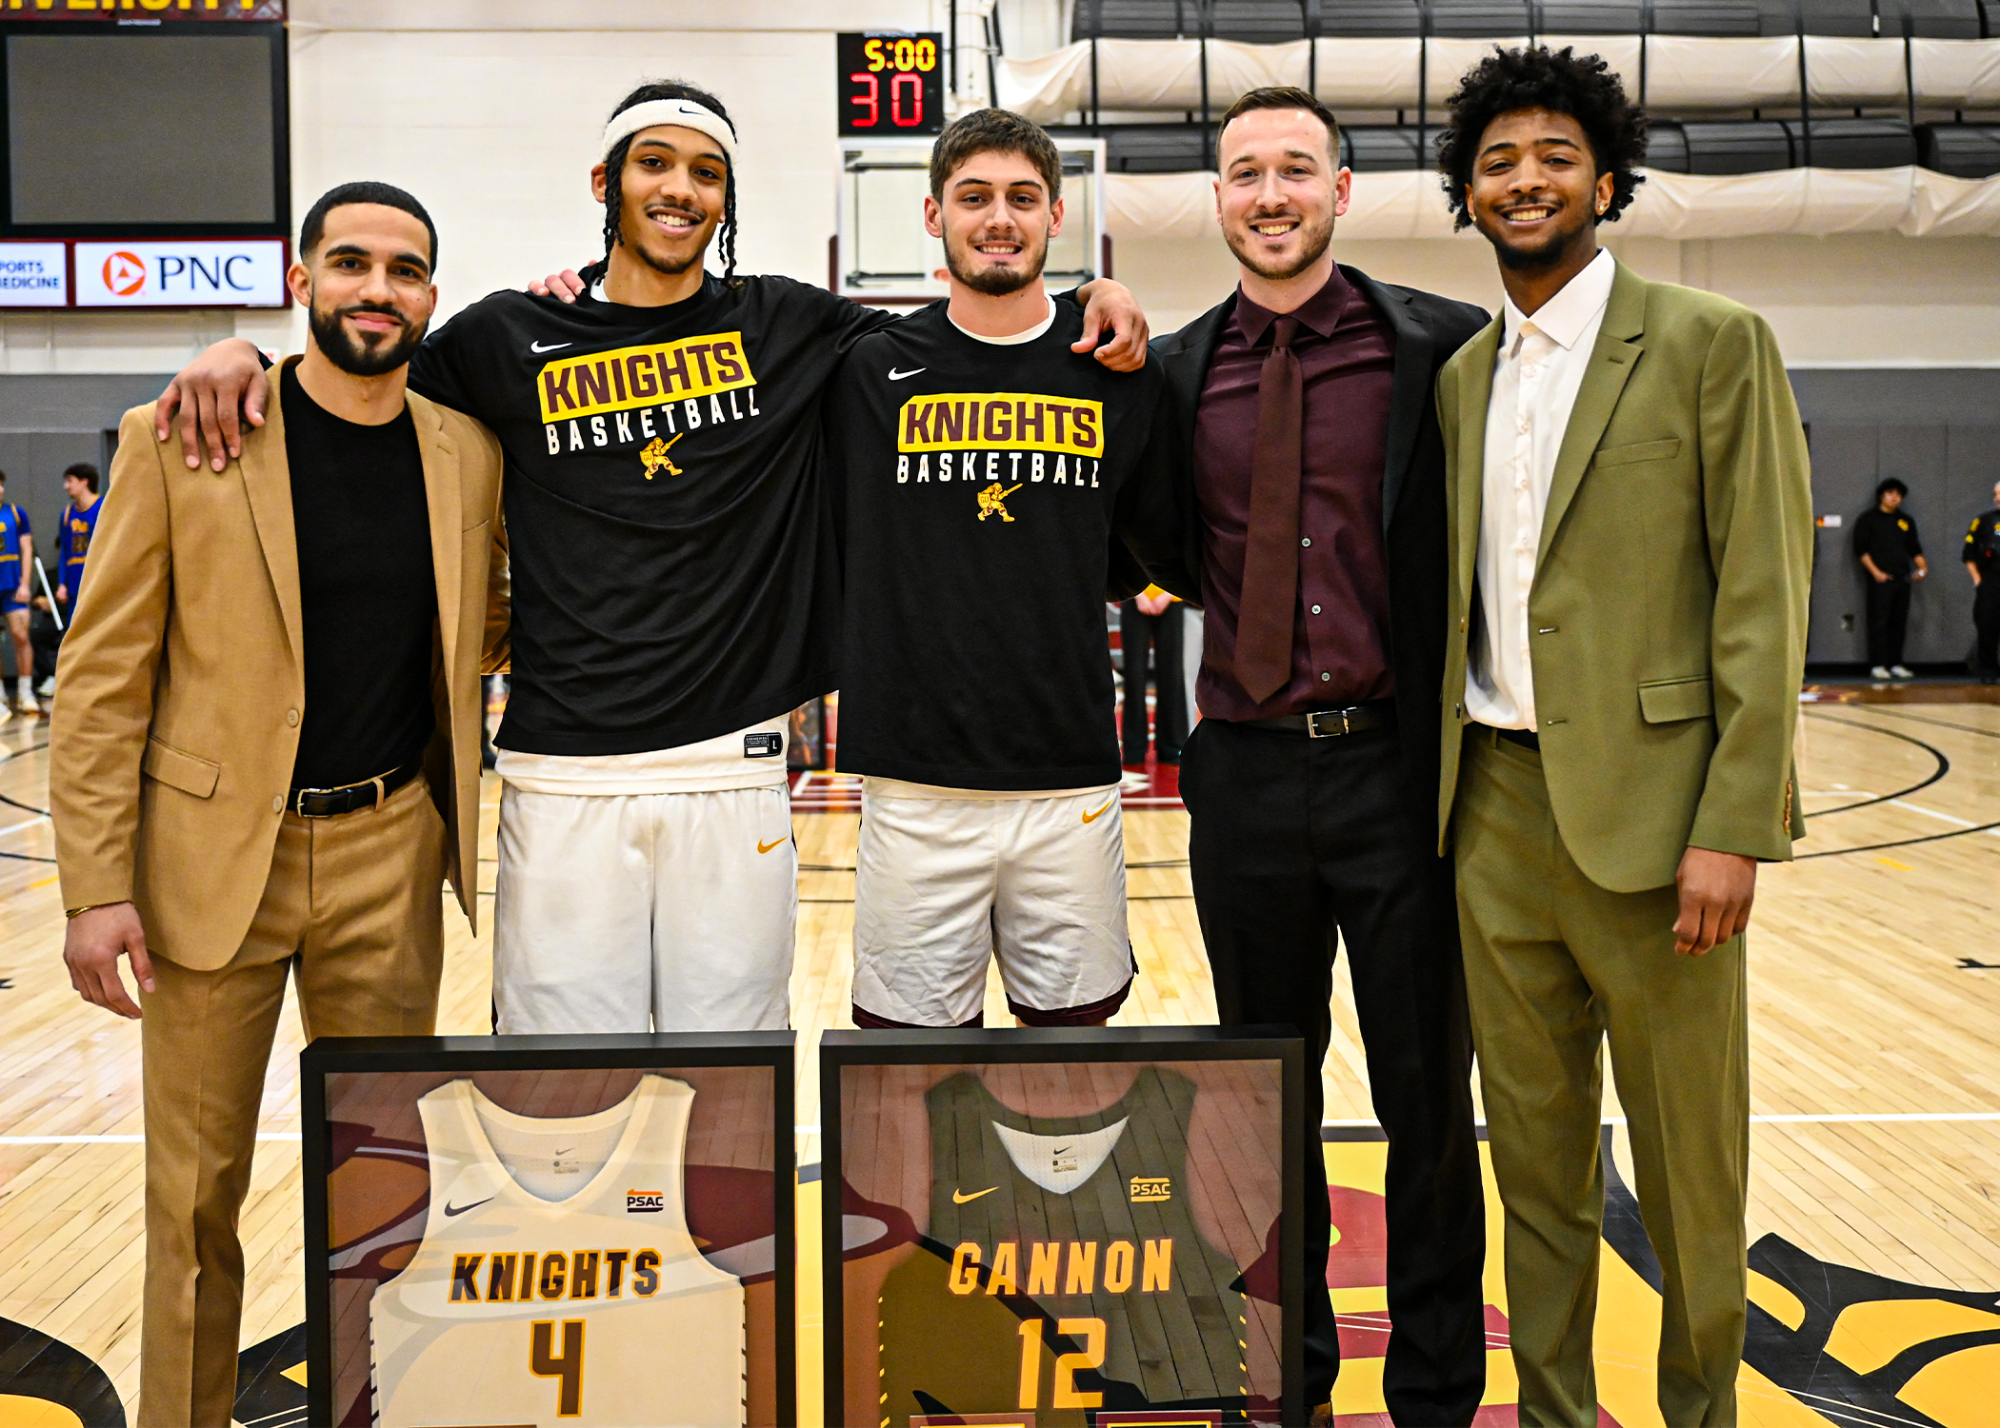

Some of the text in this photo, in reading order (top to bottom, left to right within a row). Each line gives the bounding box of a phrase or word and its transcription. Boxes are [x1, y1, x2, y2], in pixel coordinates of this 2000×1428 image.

[864, 38, 936, 72] 5:00
[850, 72, 923, 127] 30
[0, 276, 61, 290] EDICINE
[156, 255, 254, 291] PNC
[543, 341, 745, 414] KNIGHTS
[545, 387, 760, 455] BASKETBALL
[905, 401, 1097, 449] KNIGHTS
[896, 452, 1100, 488] BASKETBALL
[627, 1196, 664, 1207] PSAC
[1130, 1183, 1171, 1196] PSAC
[448, 1248, 663, 1304] KNIGHTS
[948, 1238, 1173, 1296] GANNON
[528, 1319, 586, 1418] 4
[1017, 1317, 1107, 1410] 12
